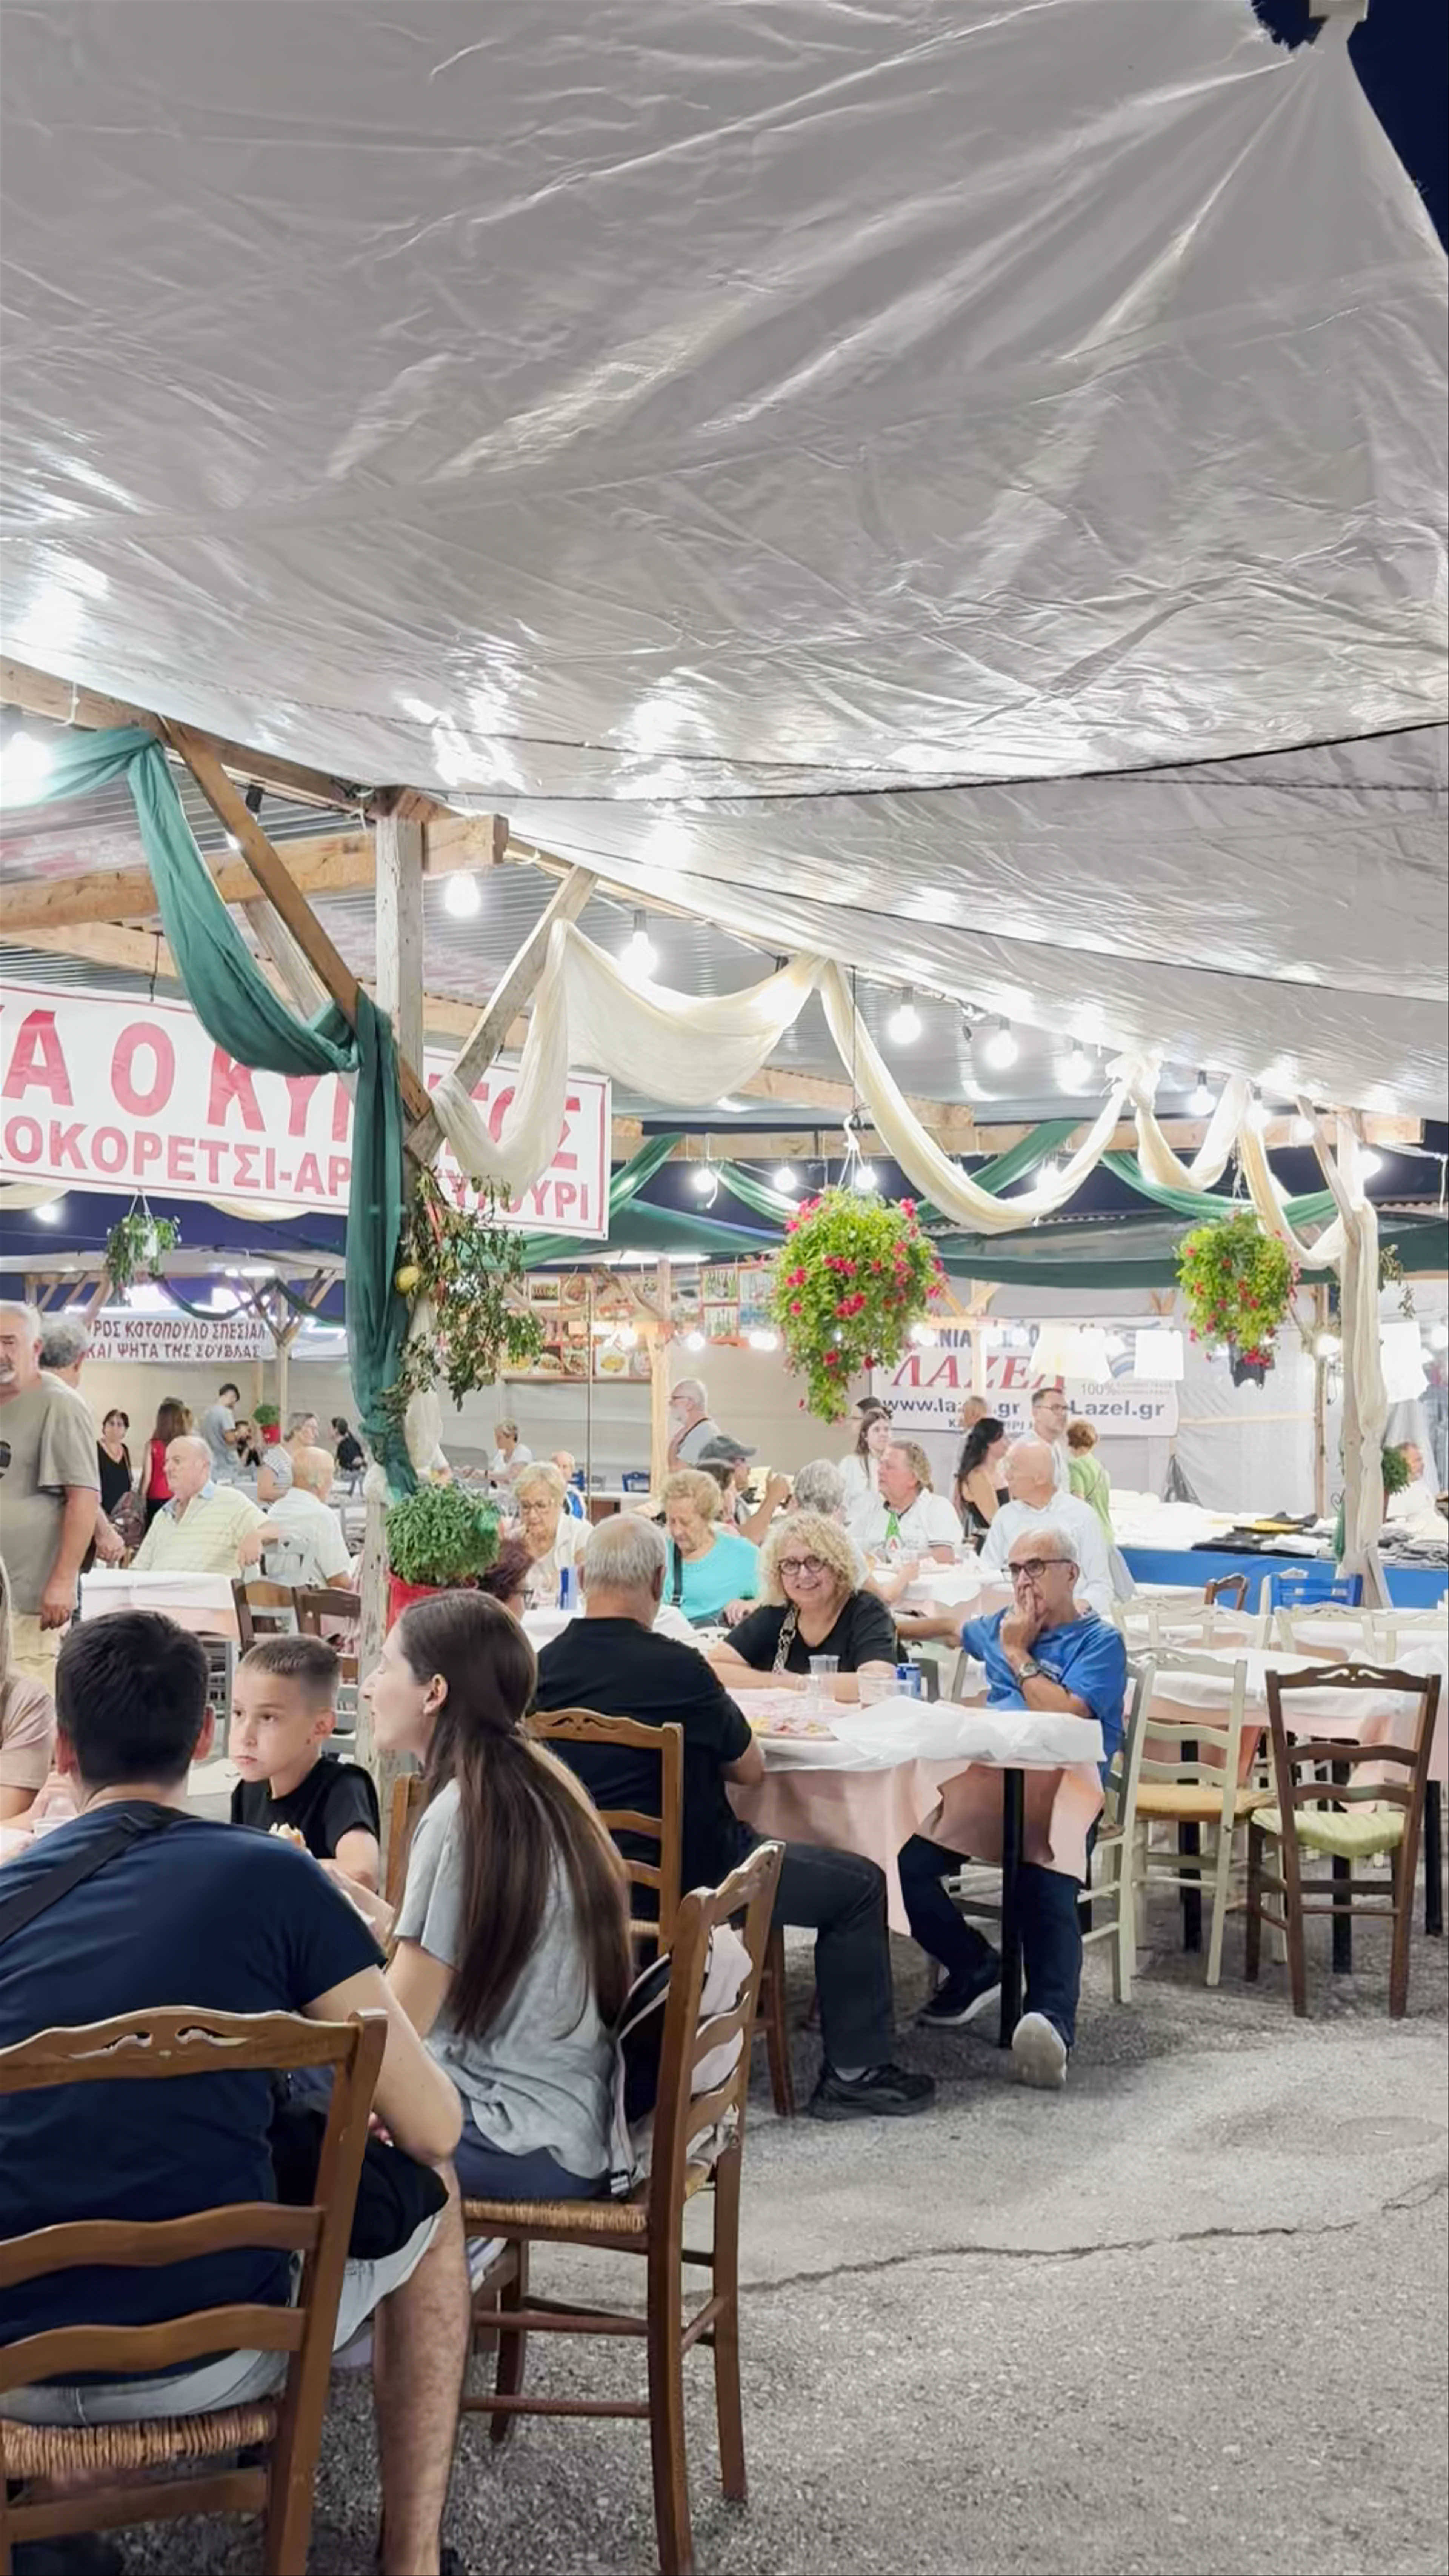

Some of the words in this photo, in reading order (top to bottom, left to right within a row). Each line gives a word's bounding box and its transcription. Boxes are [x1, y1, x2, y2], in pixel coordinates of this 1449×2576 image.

[0, 1004, 74, 1106] Α
[111, 1021, 176, 1118] Ο
[125, 1321, 208, 1339] ΚΟΤΟΠΟΥΛΟ
[87, 1342, 111, 1358] ΚΑΙ
[117, 1342, 158, 1358] ΨΗΤΑ
[165, 1343, 191, 1358] ΤΗΣ
[196, 1343, 260, 1358] ΣΟΥΒΛΑΣ
